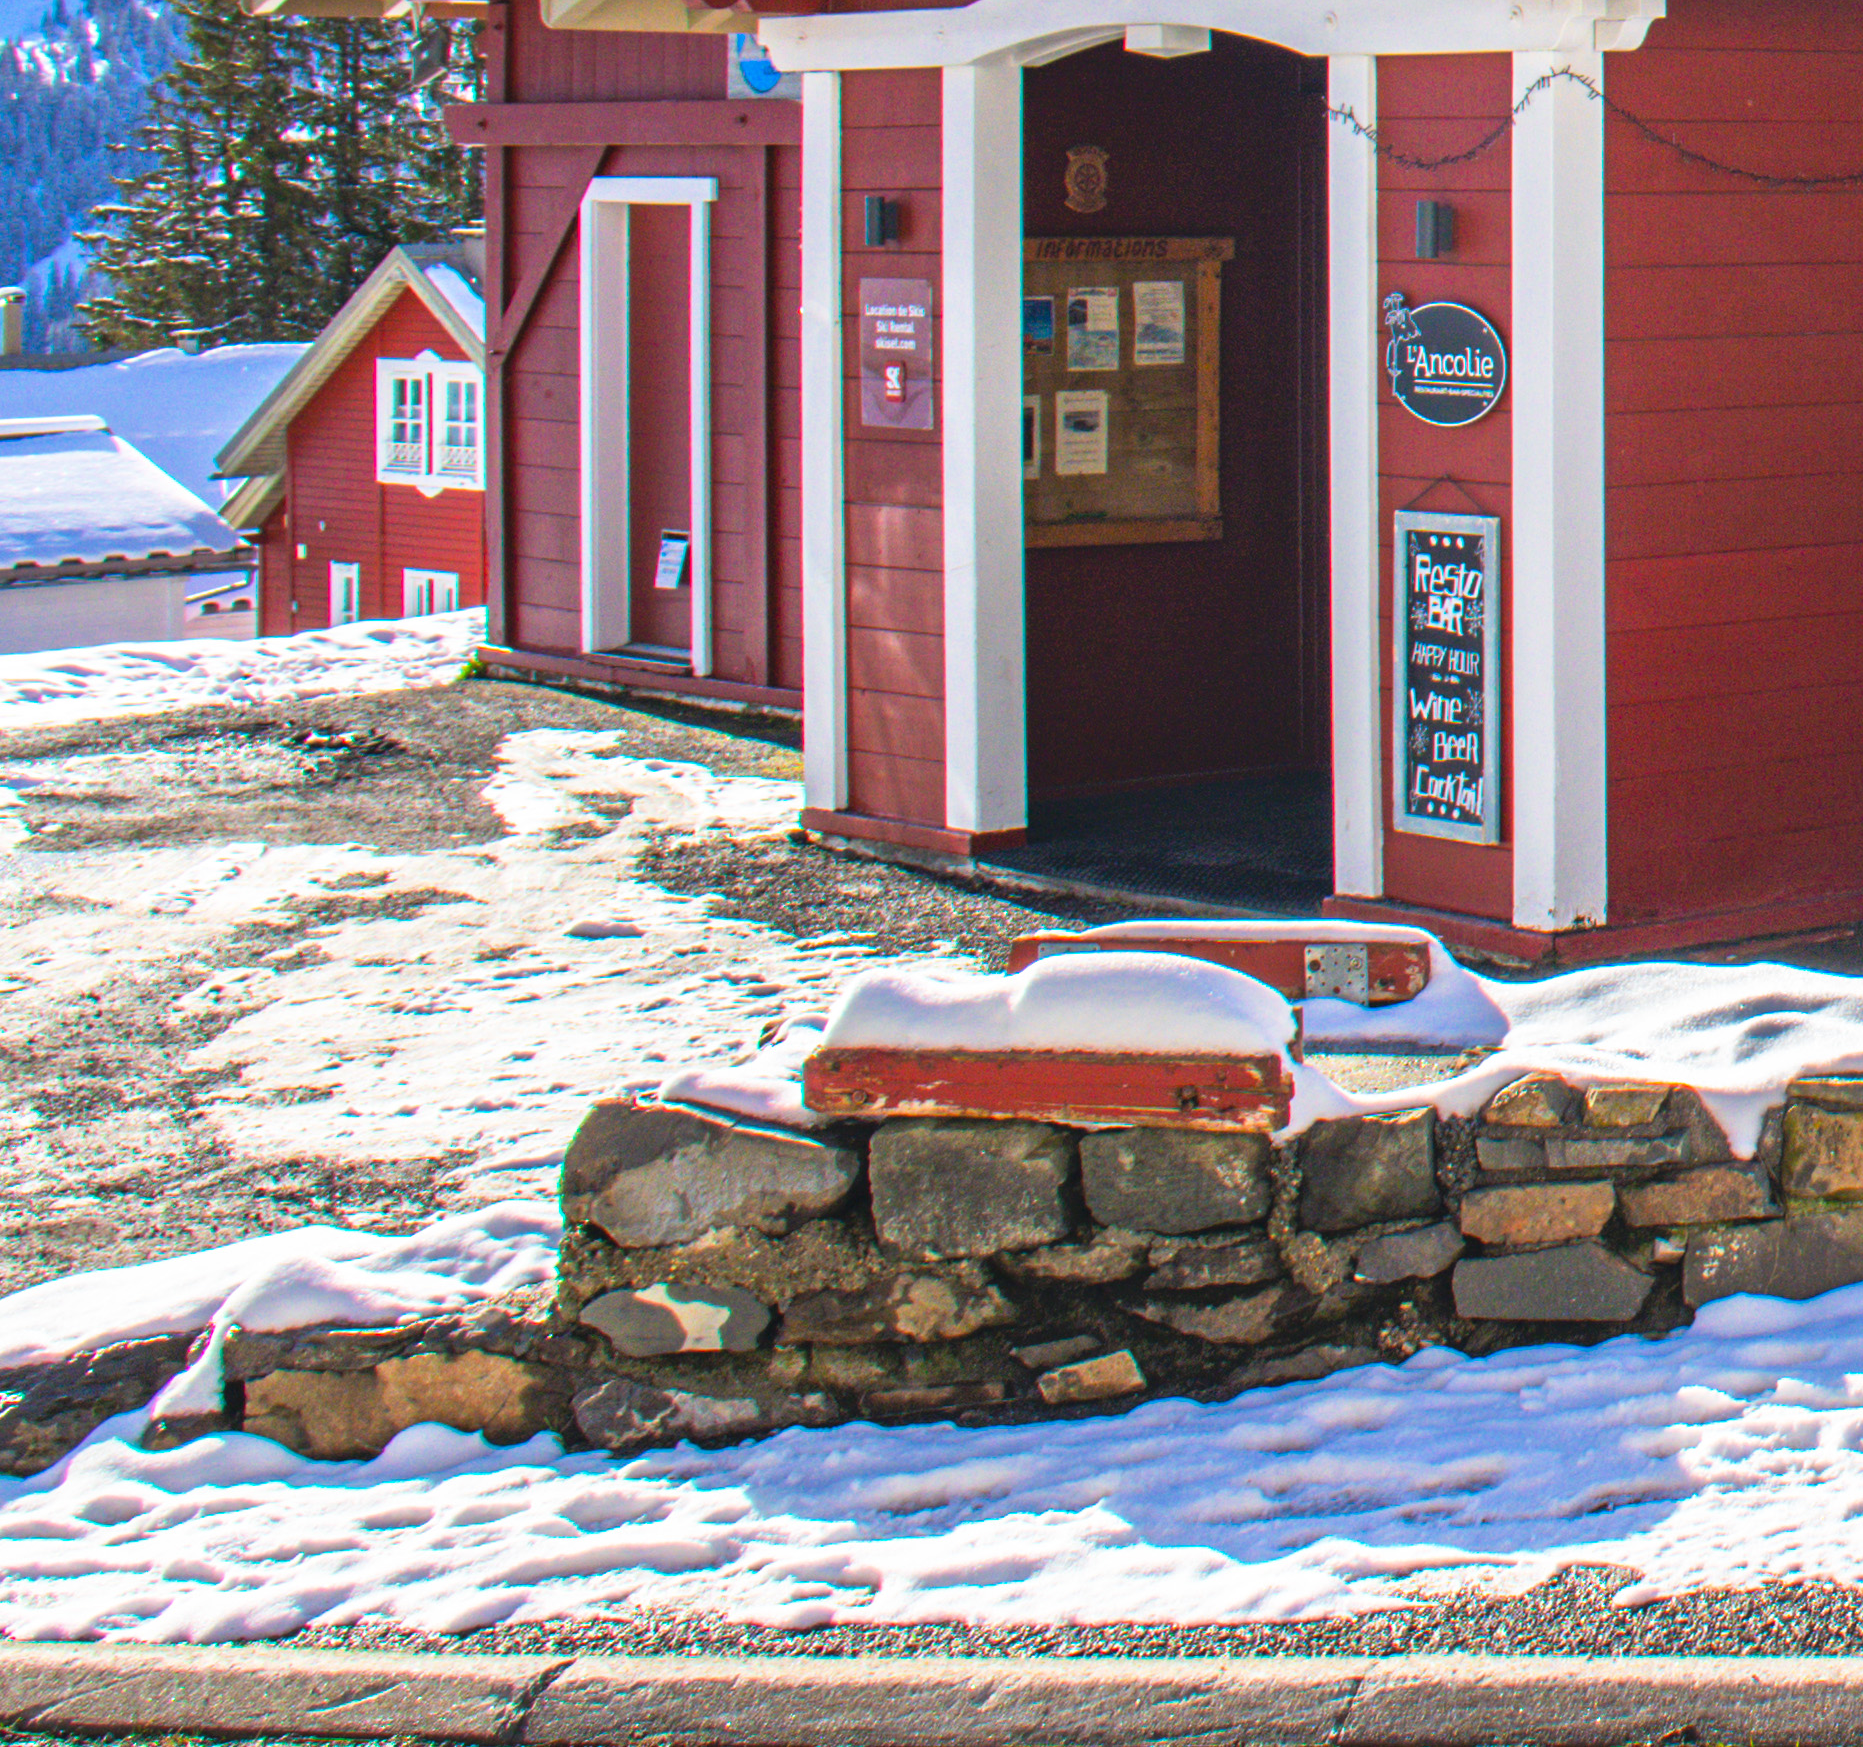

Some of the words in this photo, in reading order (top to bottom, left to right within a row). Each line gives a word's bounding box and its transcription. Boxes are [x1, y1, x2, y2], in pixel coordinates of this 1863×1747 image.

[1406, 345, 1494, 379] L'Ancolie
[1414, 553, 1483, 599] Resto
[1426, 594, 1465, 636] BAR
[1411, 641, 1447, 667] HAPPY
[1448, 647, 1480, 676] HOUR
[1410, 687, 1463, 724] Wine
